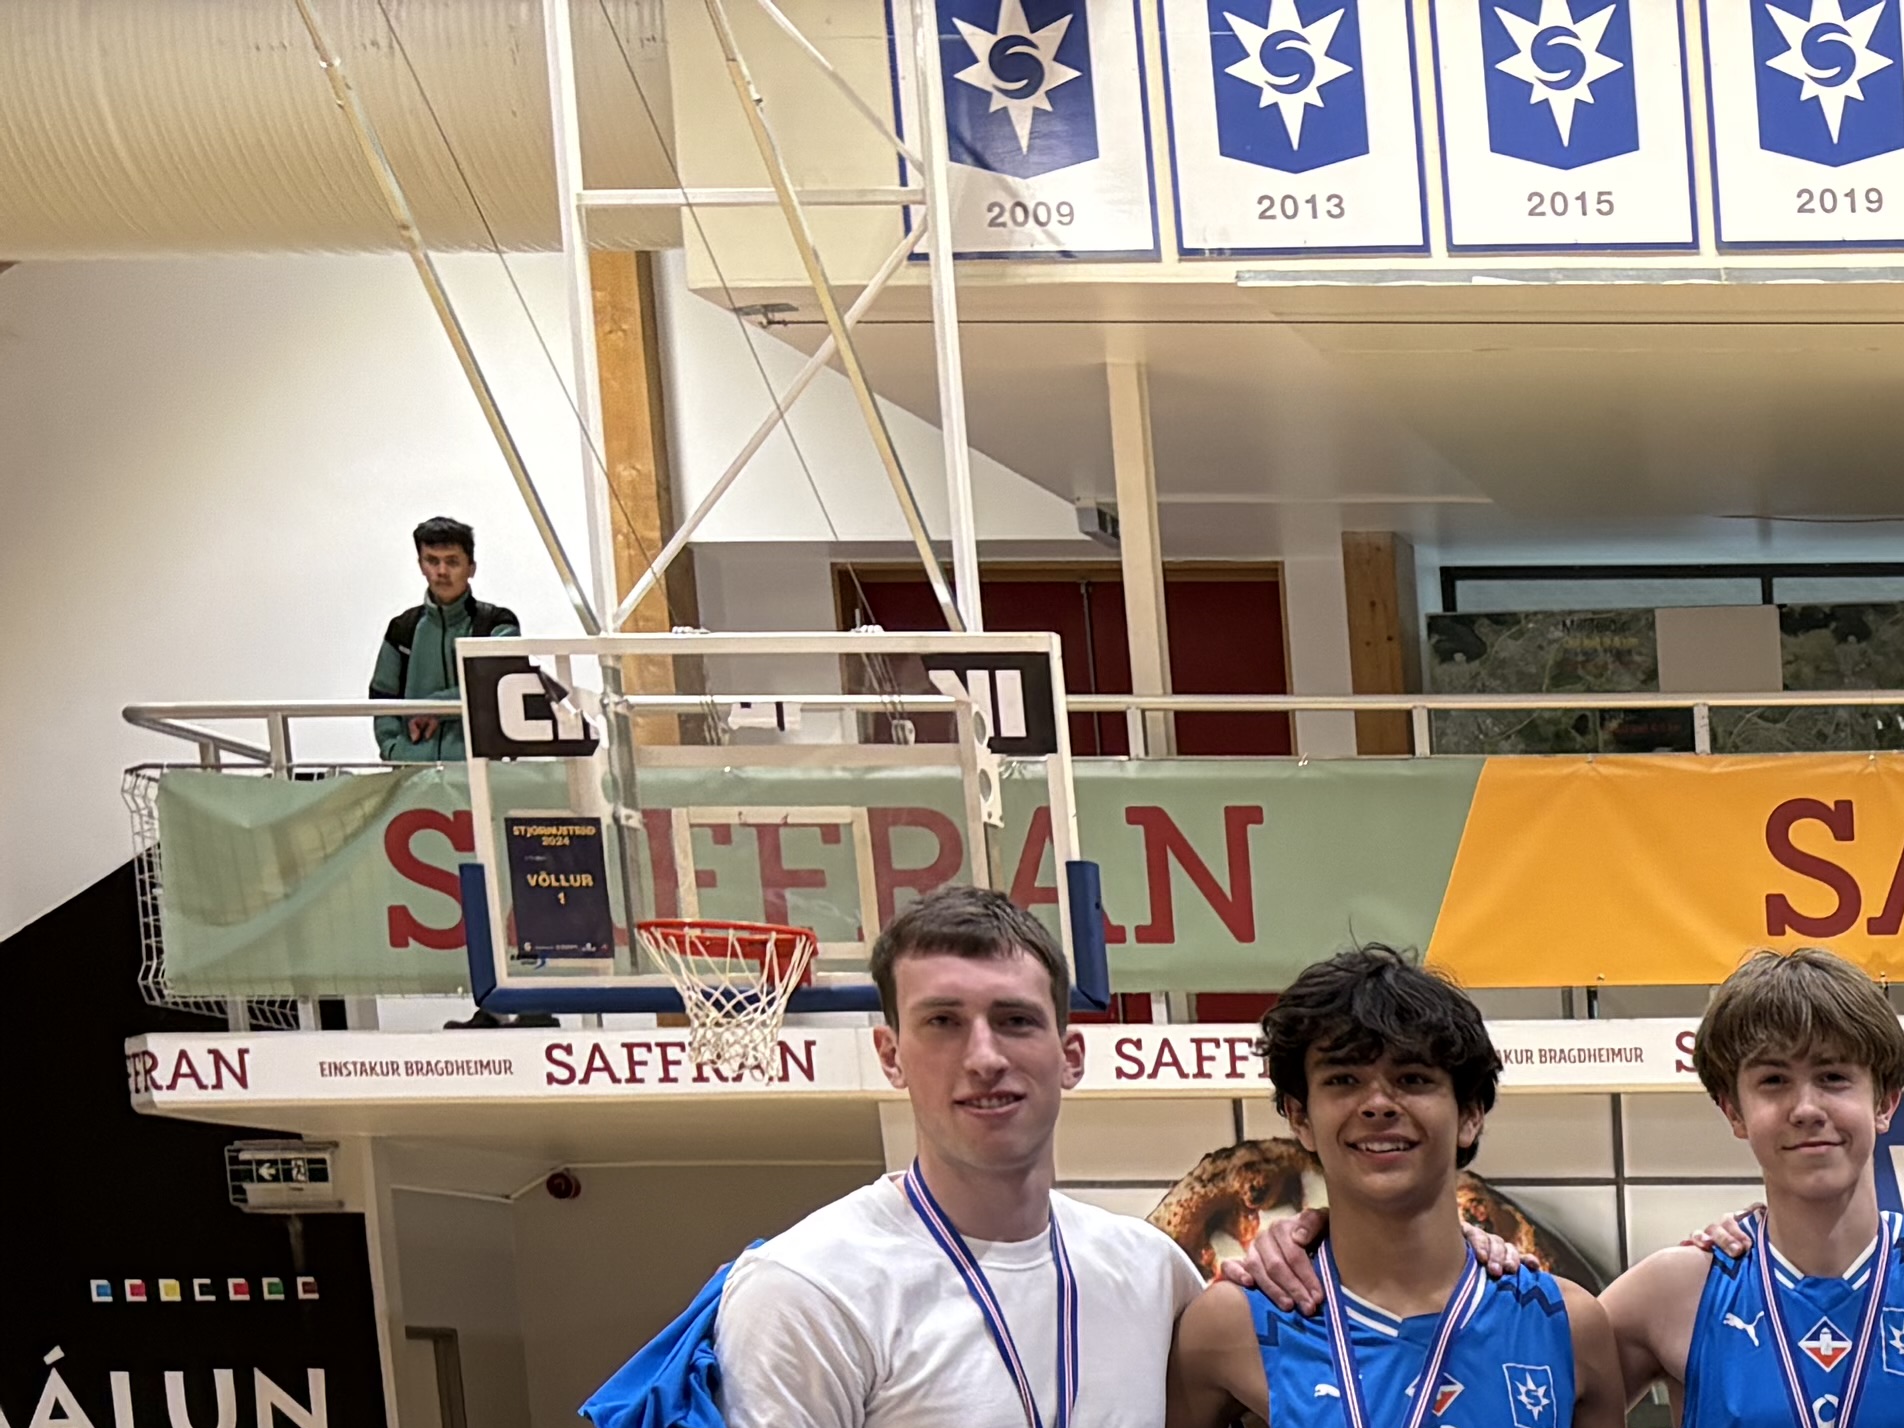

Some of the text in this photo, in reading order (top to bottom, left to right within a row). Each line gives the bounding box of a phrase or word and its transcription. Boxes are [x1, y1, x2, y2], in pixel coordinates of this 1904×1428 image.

[1256, 193, 1347, 222] 2013
[1526, 190, 1616, 218] 2015
[1794, 187, 1884, 215] 2019
[985, 201, 1075, 230] 2009
[318, 1059, 402, 1078] EINSTAKUR
[1115, 1037, 1268, 1080] SAFF
